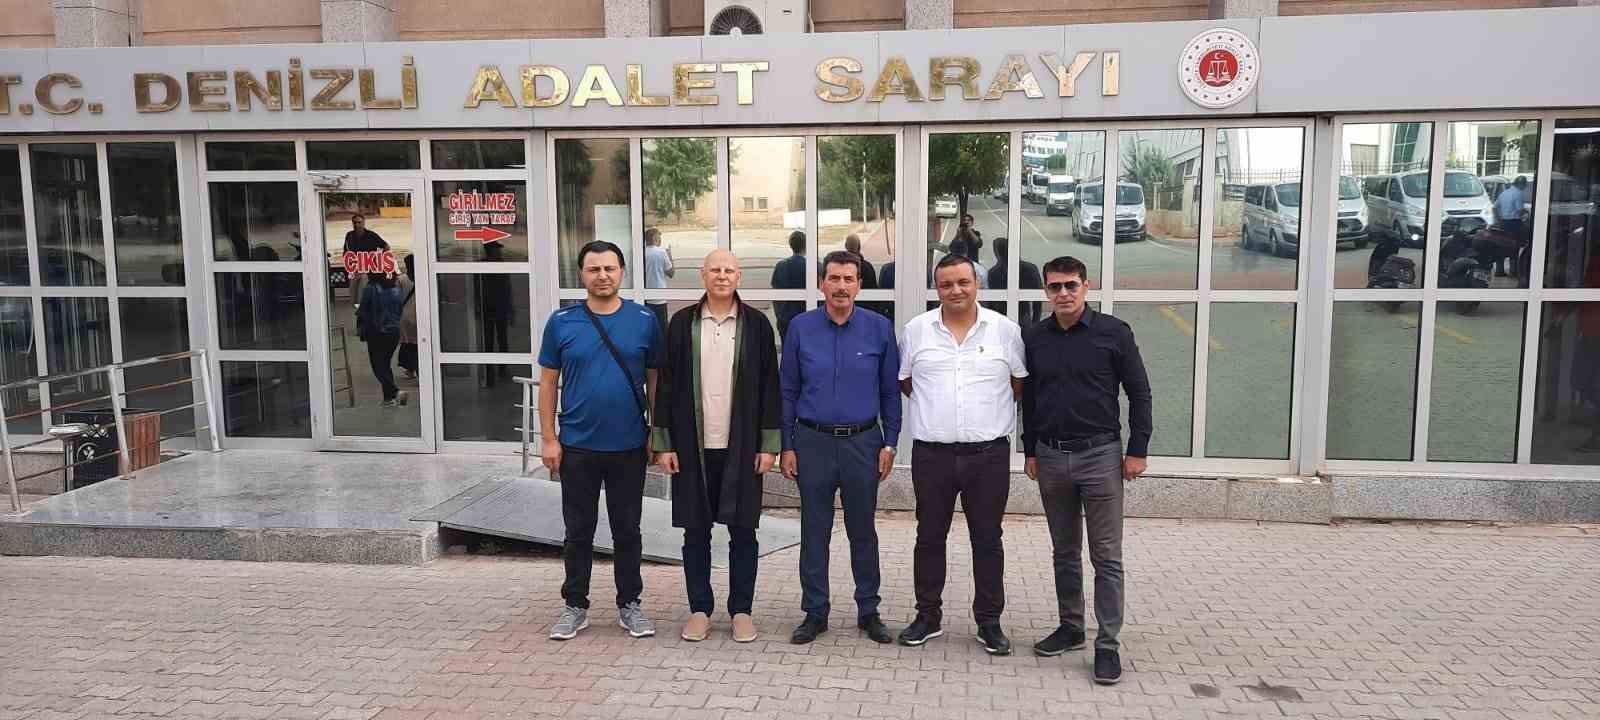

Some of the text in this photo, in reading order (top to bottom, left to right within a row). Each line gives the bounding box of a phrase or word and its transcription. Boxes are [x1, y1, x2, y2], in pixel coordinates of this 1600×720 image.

[0, 50, 1121, 115] T.C. DENİZLİ ADALET SARAYI
[449, 189, 516, 211] GİRİLMEZ
[449, 211, 516, 227] GİRİŞ YAN TARAF
